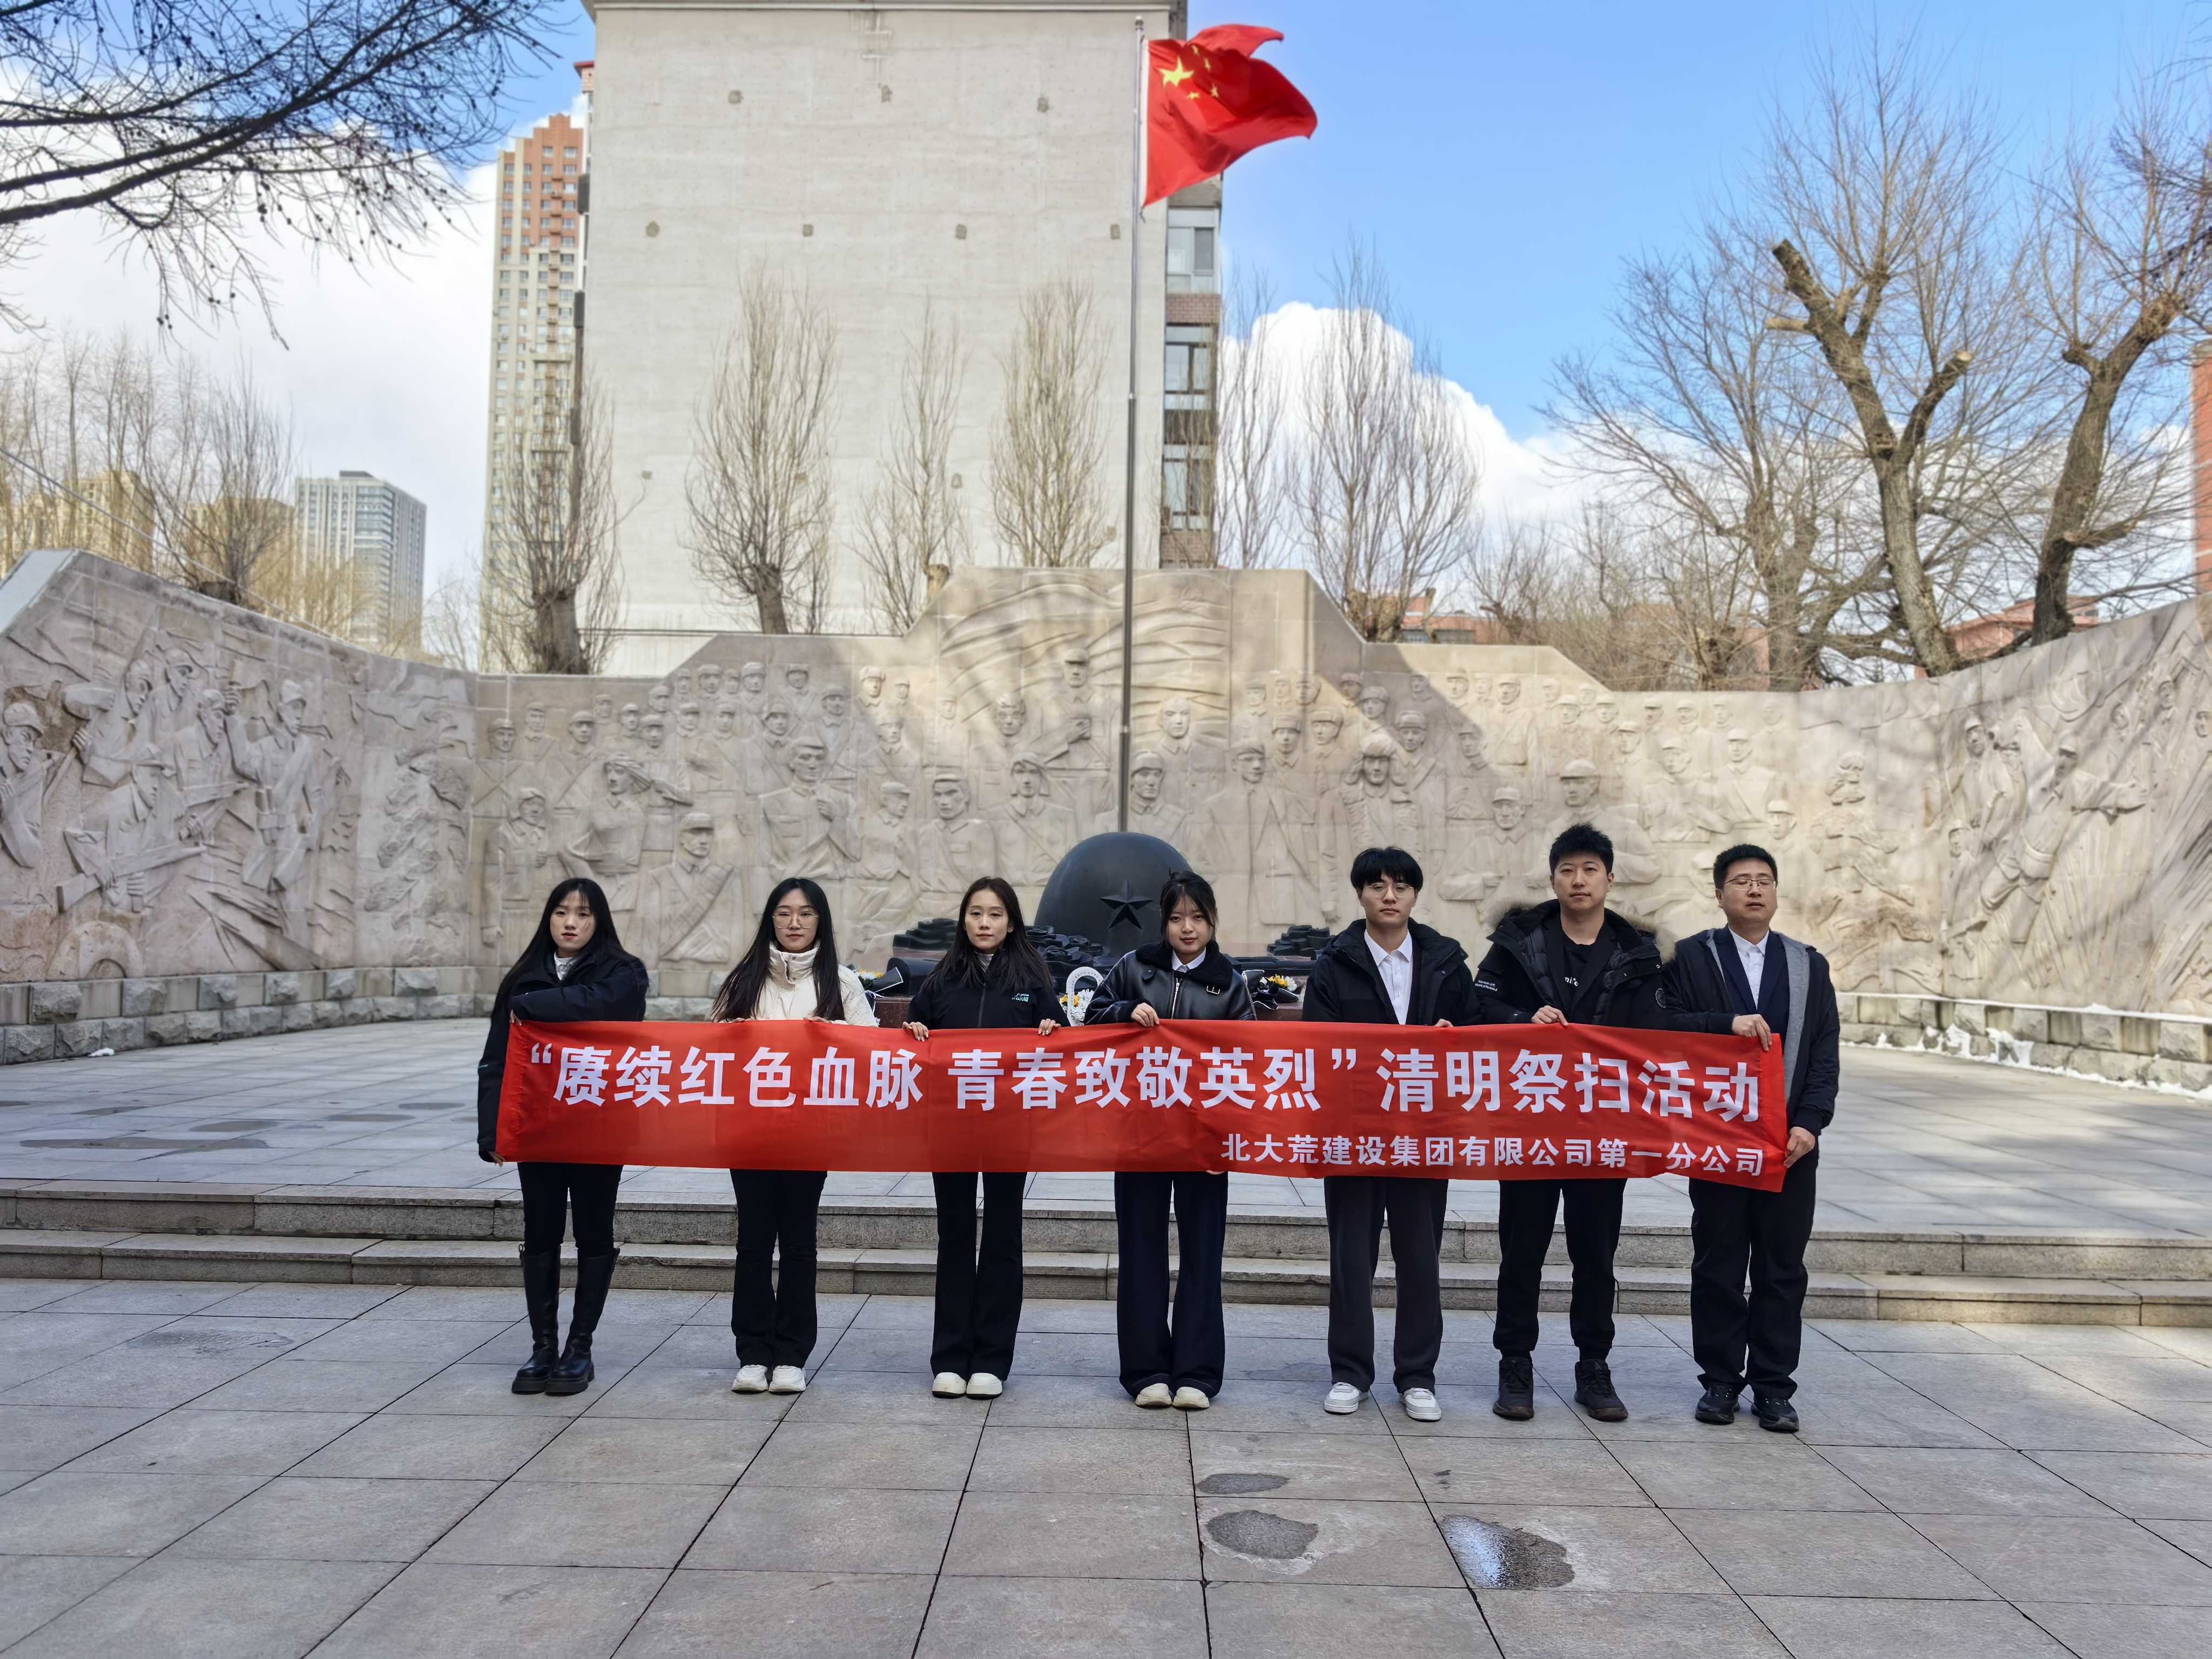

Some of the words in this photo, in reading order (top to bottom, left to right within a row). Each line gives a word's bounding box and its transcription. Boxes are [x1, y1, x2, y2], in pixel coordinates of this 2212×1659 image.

[1221, 1134, 1764, 1176] 北大荒建设集团有限公司第一分公司
